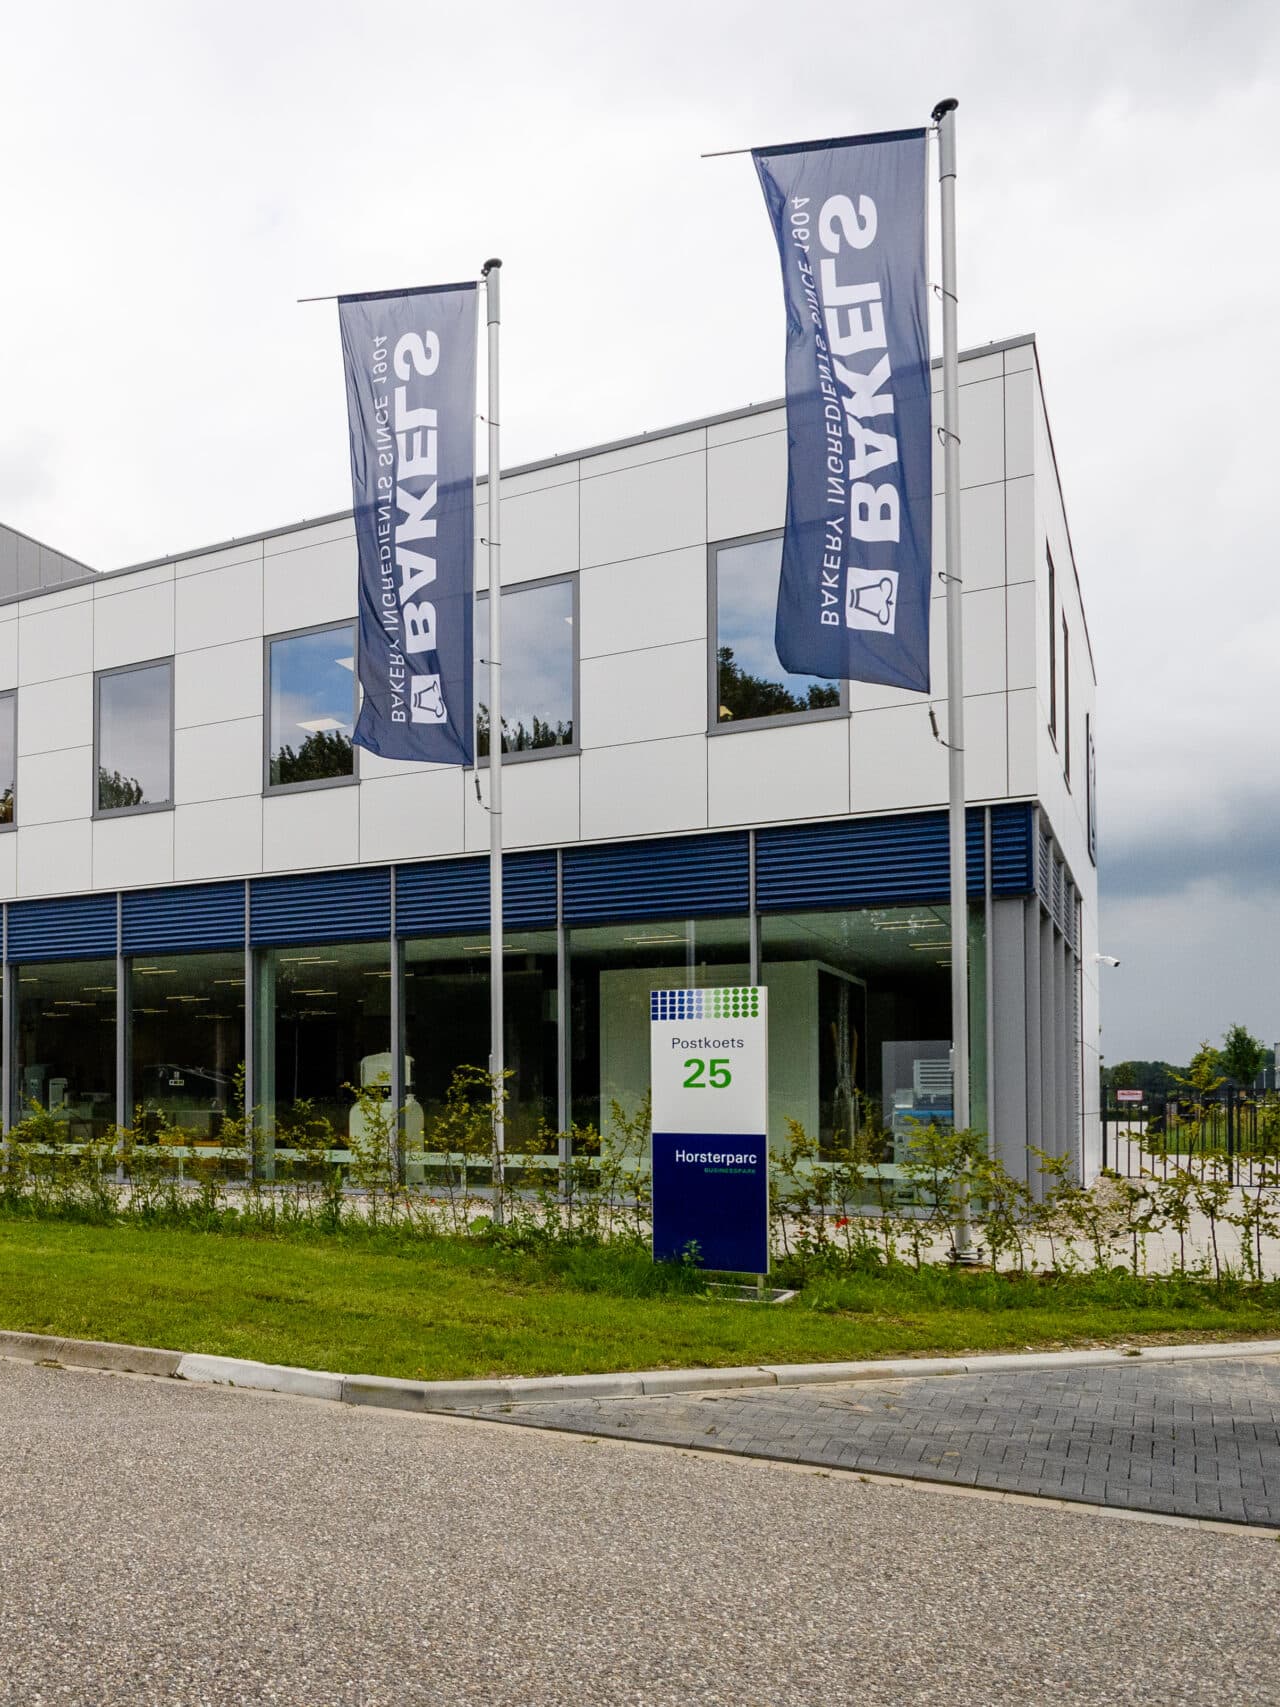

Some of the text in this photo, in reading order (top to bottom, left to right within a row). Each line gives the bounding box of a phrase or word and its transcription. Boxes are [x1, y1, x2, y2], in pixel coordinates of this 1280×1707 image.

[671, 1037, 745, 1049] Postkoets
[682, 1058, 732, 1089] 25
[675, 1149, 758, 1167] Horsterparc
